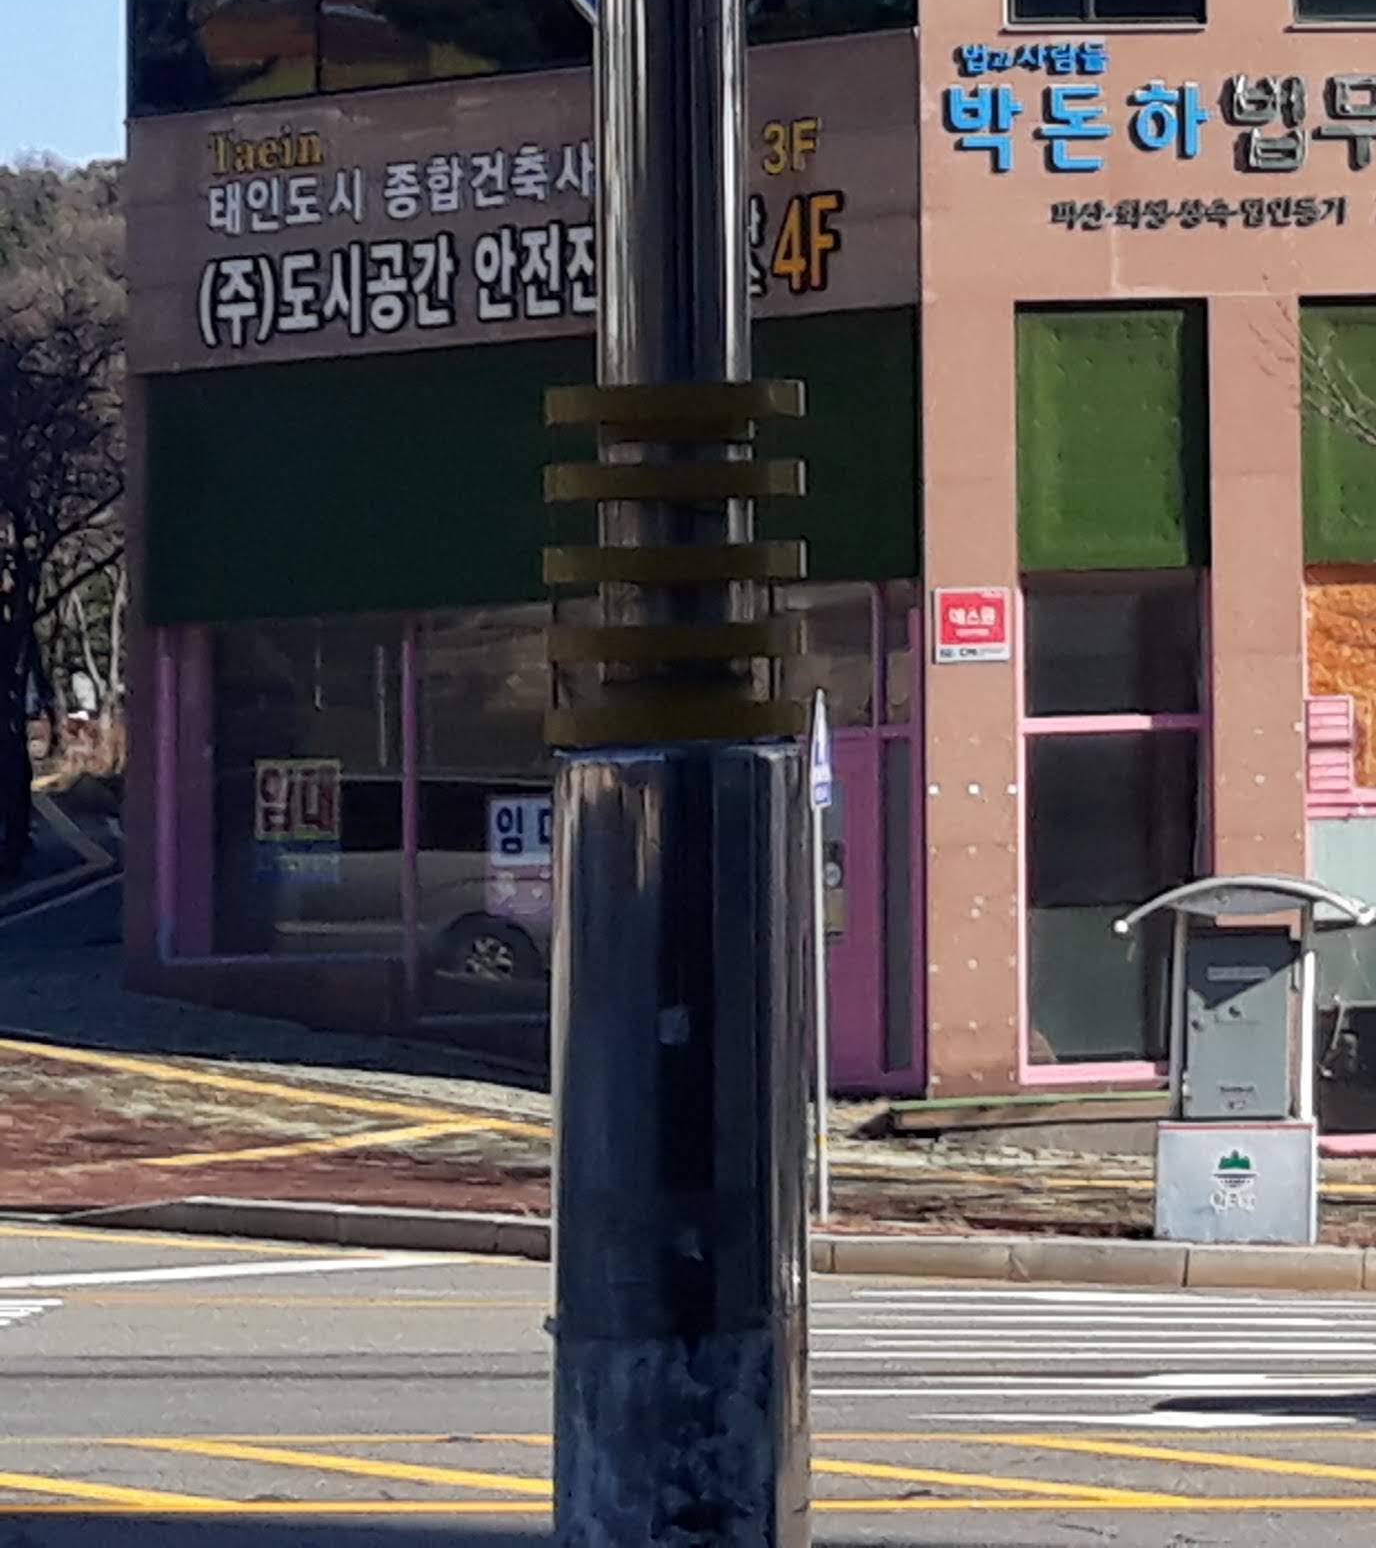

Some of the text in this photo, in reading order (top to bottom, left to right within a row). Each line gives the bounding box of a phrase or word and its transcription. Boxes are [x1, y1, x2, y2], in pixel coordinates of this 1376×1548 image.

[763, 117, 821, 175] 3F
[945, 79, 1212, 173] 박돈하
[206, 166, 365, 235] 태인도시
[197, 230, 454, 347] (주)도시공간
[771, 190, 843, 293] 4F
